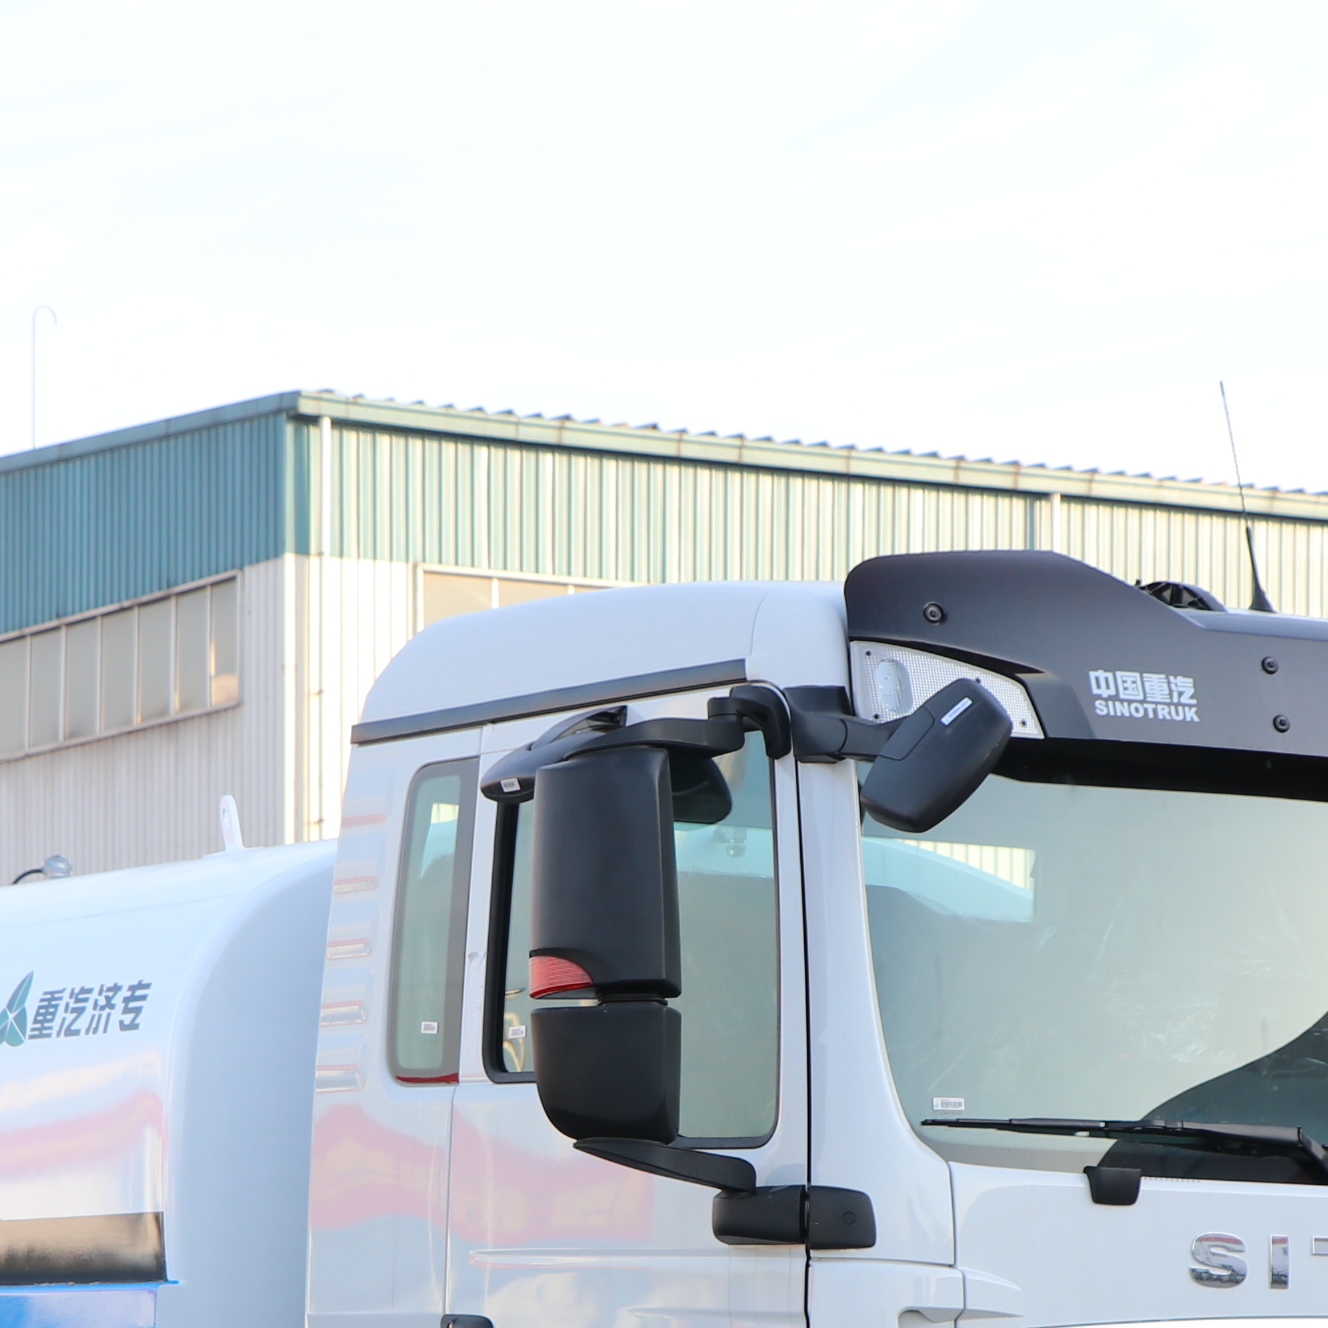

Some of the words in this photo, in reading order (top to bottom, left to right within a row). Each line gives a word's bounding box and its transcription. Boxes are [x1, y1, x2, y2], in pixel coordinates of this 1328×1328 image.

[1088, 669, 1198, 705] 中国重汽
[1094, 699, 1200, 722] SINOTRUK
[28, 979, 153, 1040] 重汽济专
